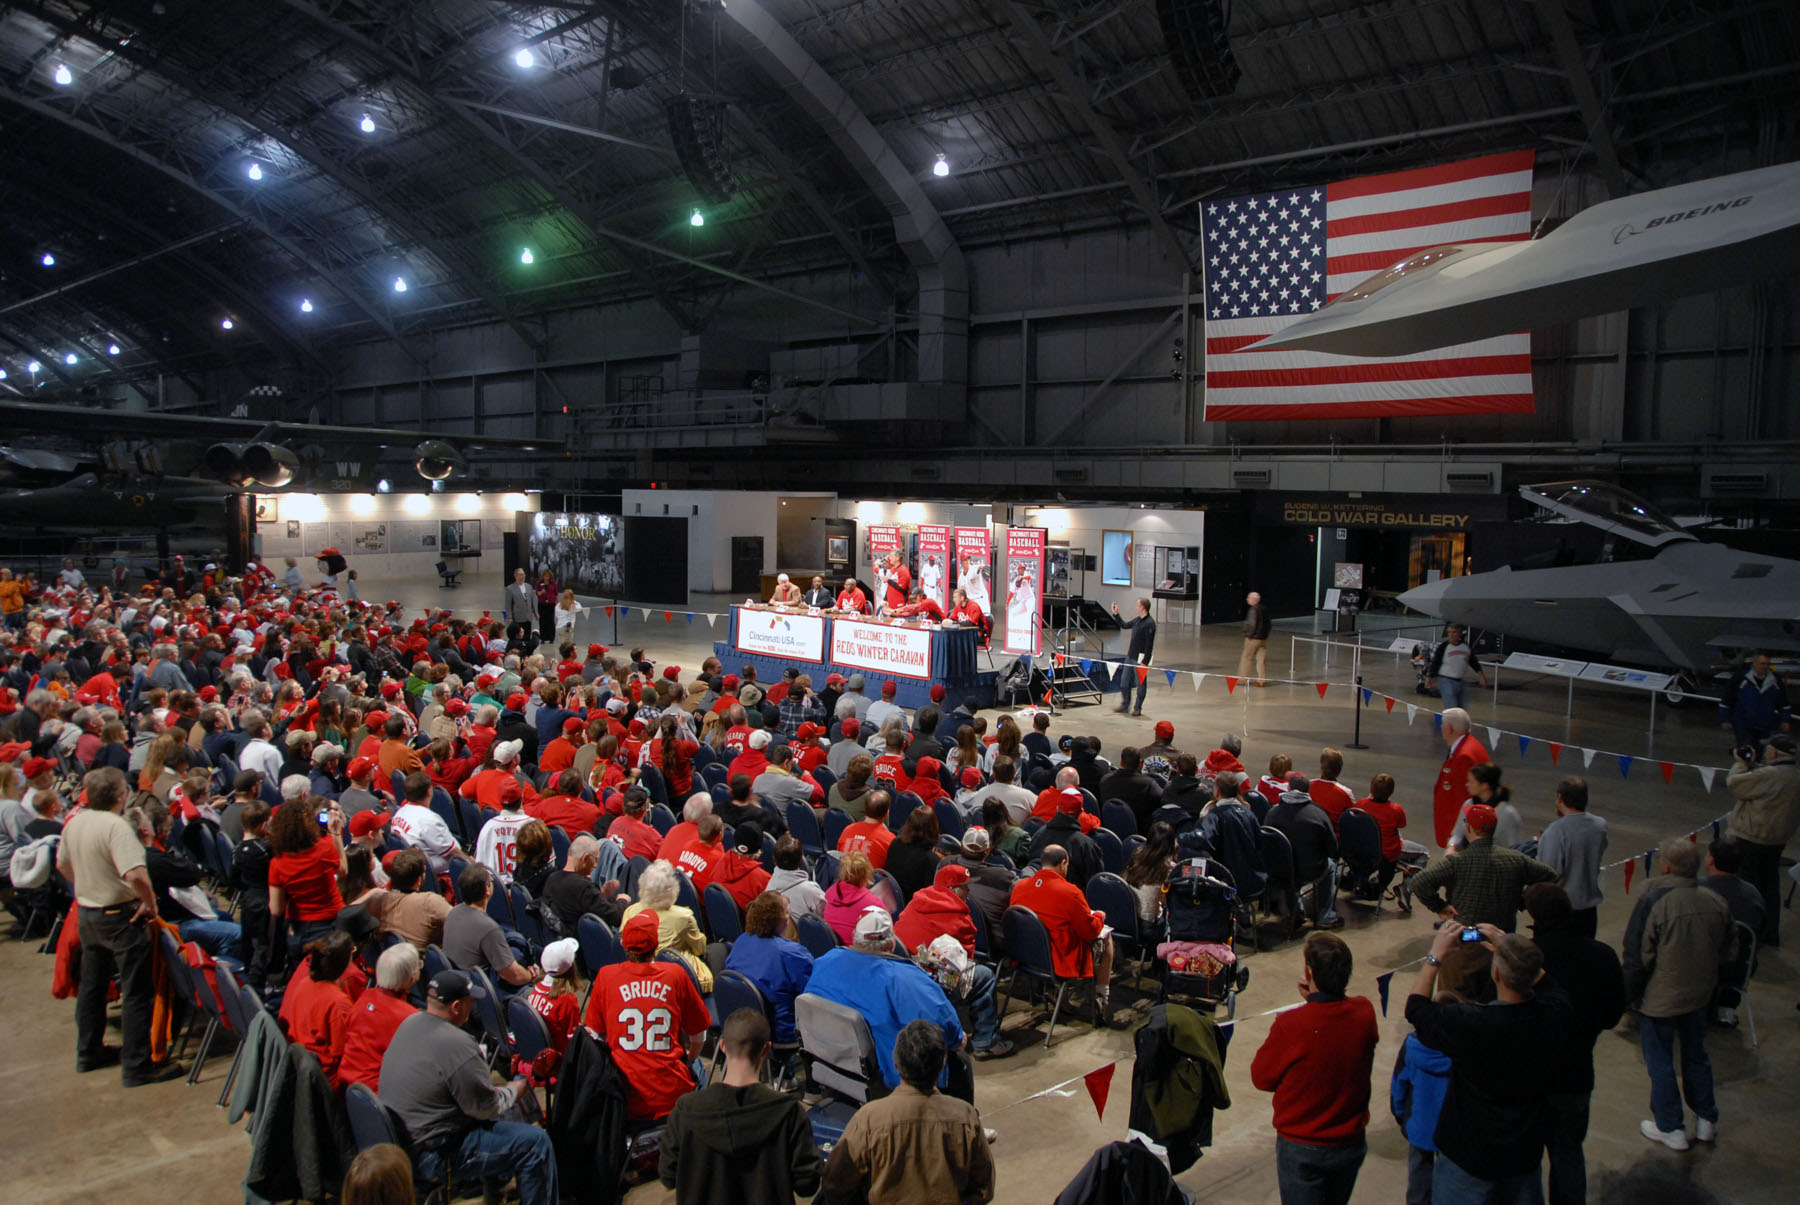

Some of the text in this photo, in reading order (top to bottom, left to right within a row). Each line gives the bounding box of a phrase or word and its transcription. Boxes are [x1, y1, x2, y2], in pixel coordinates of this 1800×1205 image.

[1645, 196, 1753, 229] BOEING
[1284, 502, 1319, 510] EUGENE
[1333, 503, 1385, 511] KETTERING
[1284, 510, 1470, 527] COLD WAR GALLERY
[560, 525, 597, 541] HONOR
[871, 533, 897, 543] BASEBALL
[920, 533, 946, 543] BASEBALL
[958, 536, 986, 547] BASEBALL
[1009, 537, 1040, 548] BASEBALL
[749, 630, 781, 644] Cincinnati
[781, 635, 795, 646] USA
[853, 628, 908, 646] WELCOME TO THE
[836, 640, 925, 667] REDS WINTER CARAVAN
[875, 763, 897, 777] BRUCE
[494, 826, 518, 837] VOTT
[679, 850, 708, 872] ARROYO
[619, 980, 672, 1002] BRUCE
[528, 993, 554, 1016] UCE
[618, 1007, 672, 1051] 32
